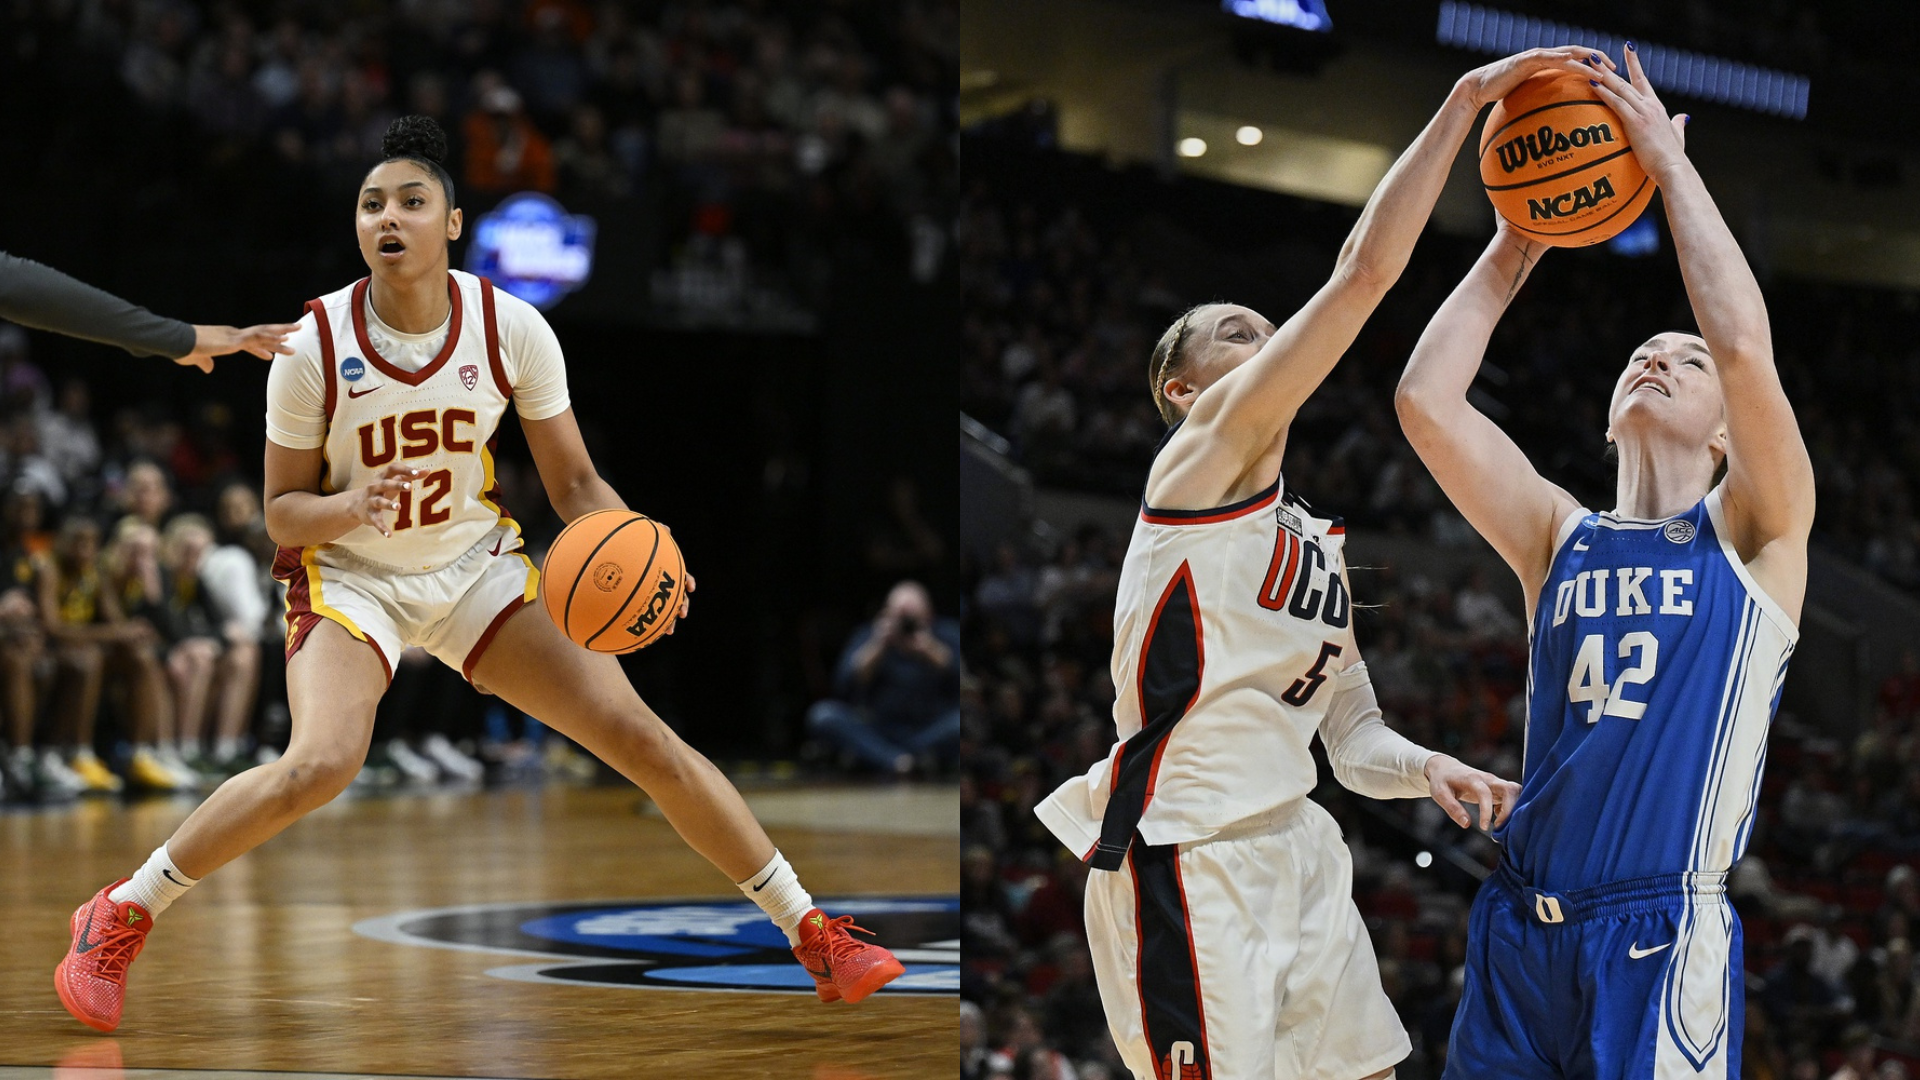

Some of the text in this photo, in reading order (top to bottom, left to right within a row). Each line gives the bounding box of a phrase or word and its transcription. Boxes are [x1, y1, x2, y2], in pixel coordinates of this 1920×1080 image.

[1496, 123, 1614, 173] Wilson
[1537, 152, 1575, 169] EVO NXT
[1527, 175, 1616, 220] NCAA
[344, 367, 363, 376] NCAA
[357, 408, 476, 469] USC
[393, 468, 453, 532] 12
[1669, 526, 1693, 535] ACC
[625, 570, 676, 637] NCAA
[1552, 567, 1694, 628] DUKE
[1281, 640, 1343, 707] 5
[1567, 631, 1659, 724] 42
